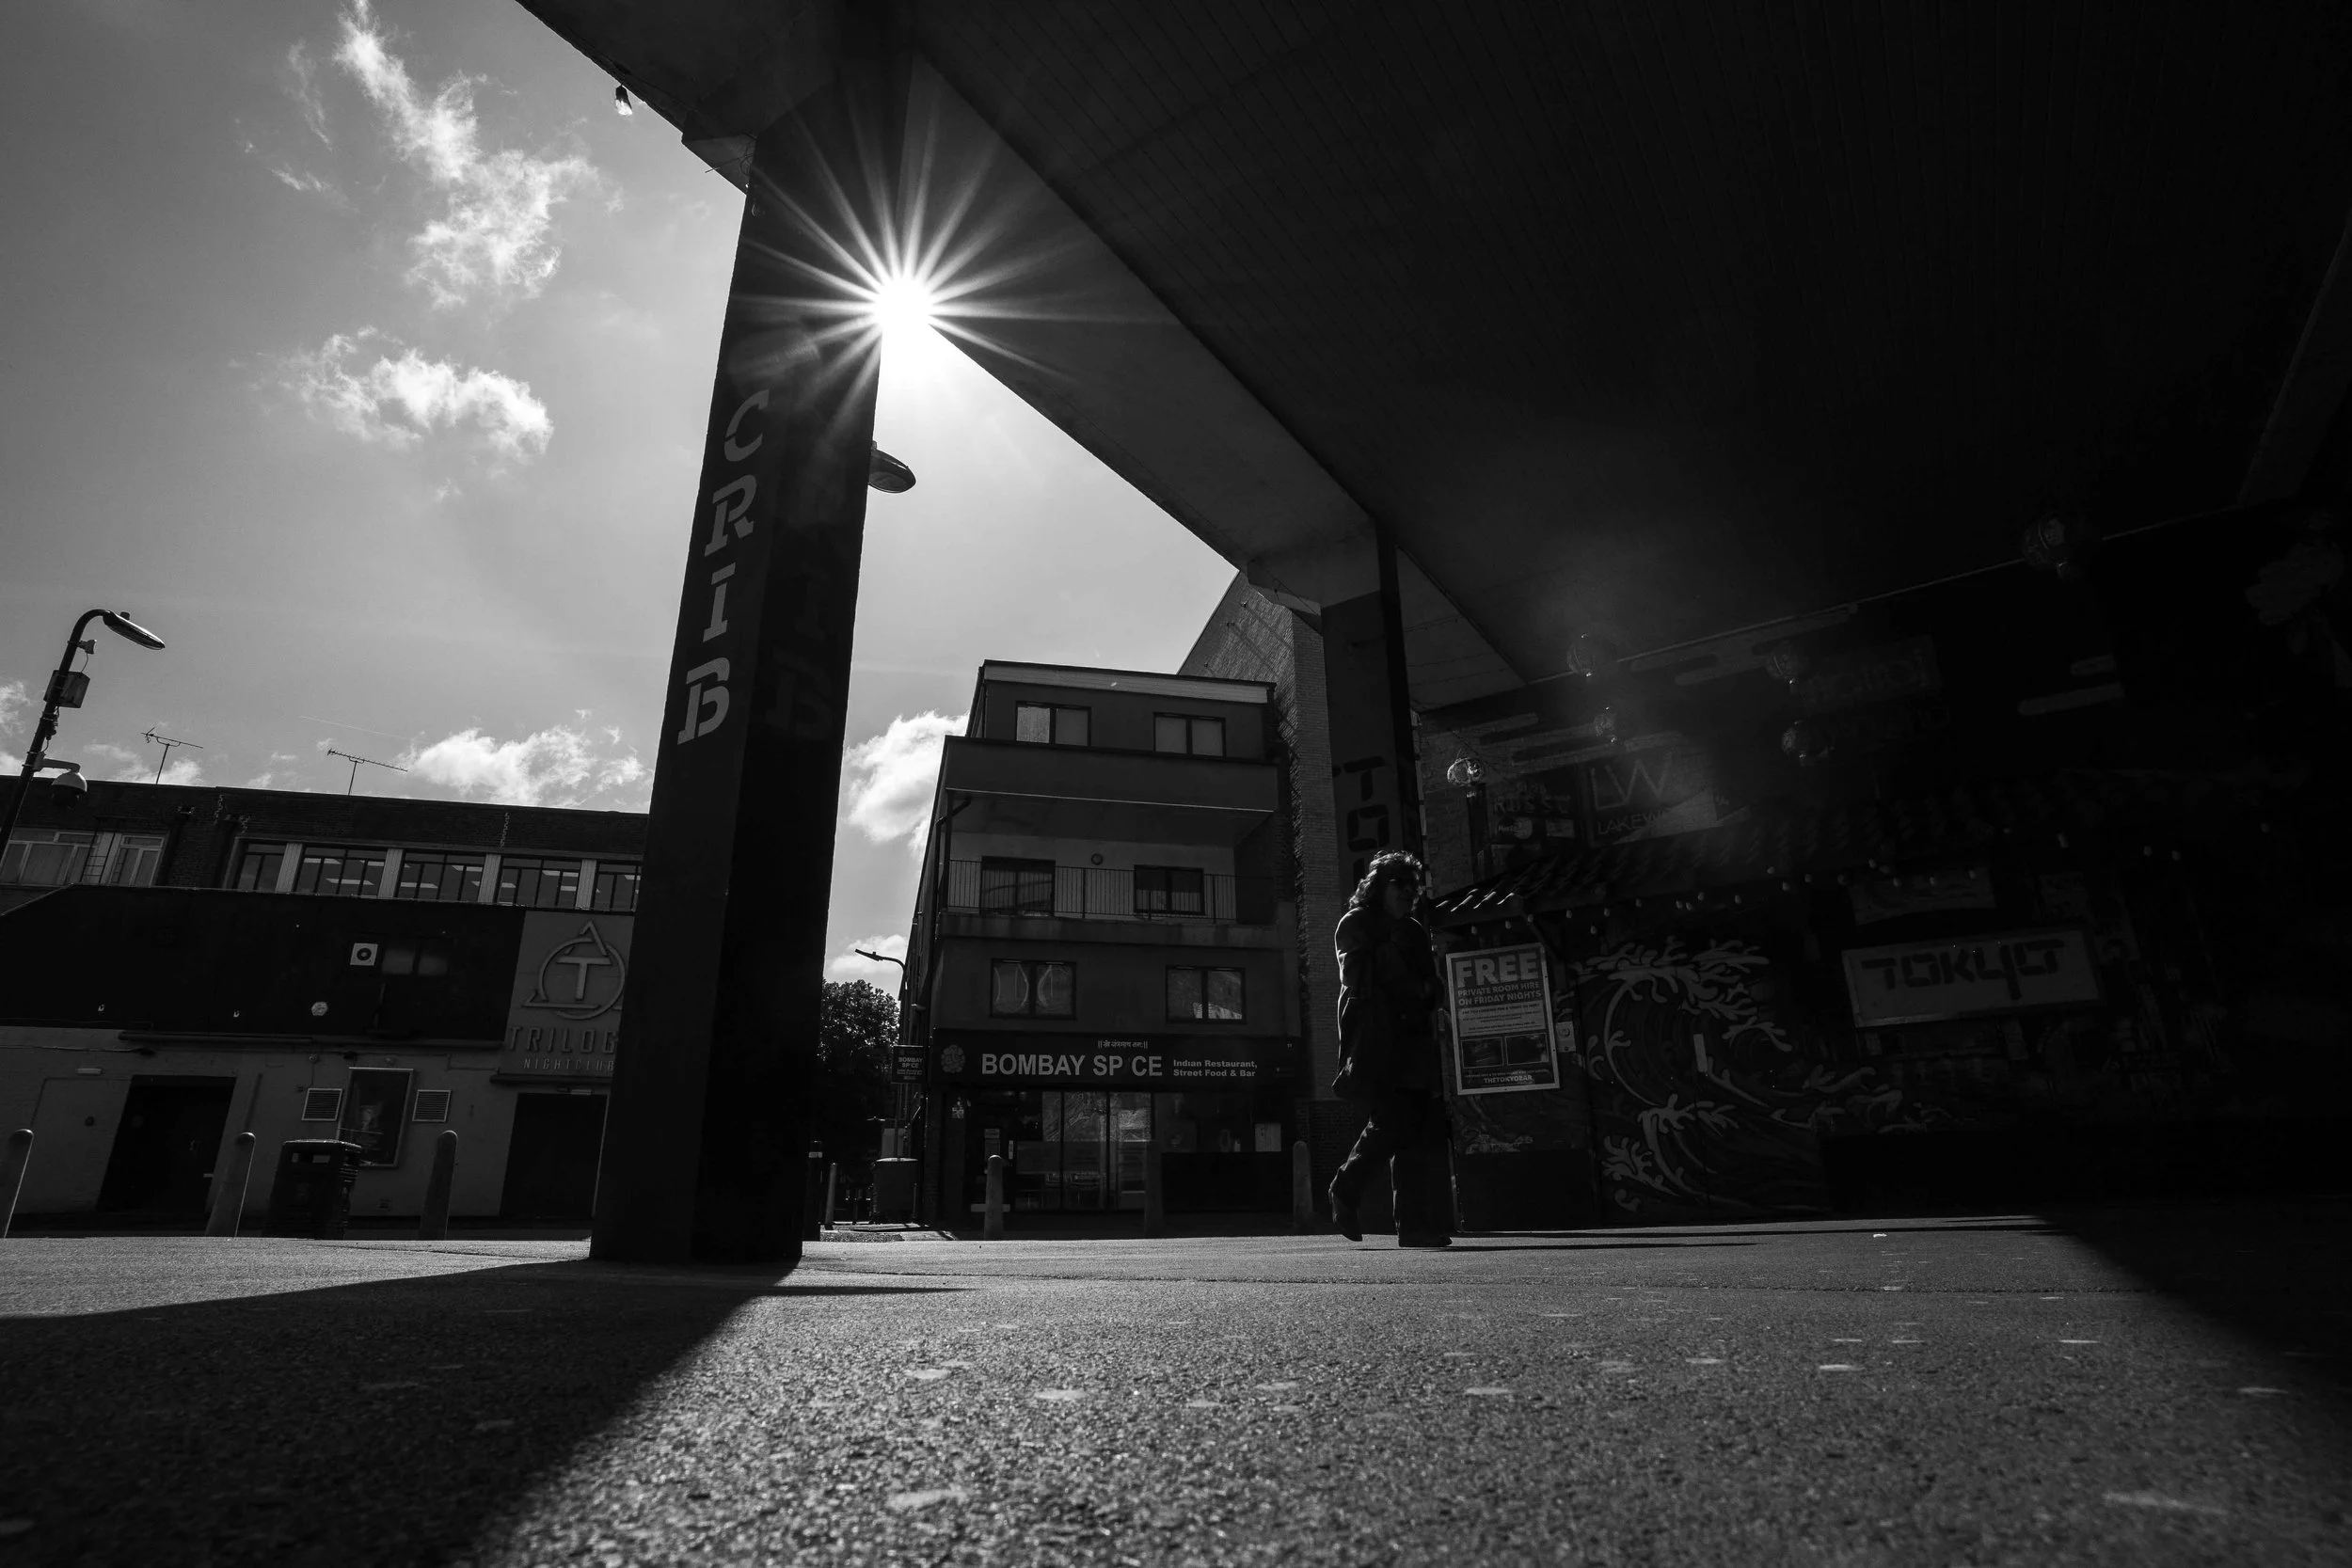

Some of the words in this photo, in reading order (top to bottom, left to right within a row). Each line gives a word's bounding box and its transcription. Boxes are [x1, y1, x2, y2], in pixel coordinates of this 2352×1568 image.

[677, 388, 770, 745] CRIB
[1455, 951, 1539, 989] FREE
[1457, 987, 1491, 997] PRIVATE
[1492, 984, 1519, 993] ROOM
[1520, 981, 1540, 990] HIRE
[1458, 997, 1472, 1006] ON
[1474, 993, 1505, 1004] FRIDAY
[1507, 990, 1542, 1001] NIGHTS
[509, 1026, 618, 1054] TRILOG
[523, 1058, 614, 1071] NIGHTCLUB
[981, 1053, 1086, 1075] BOMBAY
[1204, 1059, 1258, 1069] Restaurant,
[1173, 1069, 1203, 1077] Street
[1205, 1069, 1228, 1077] Food
